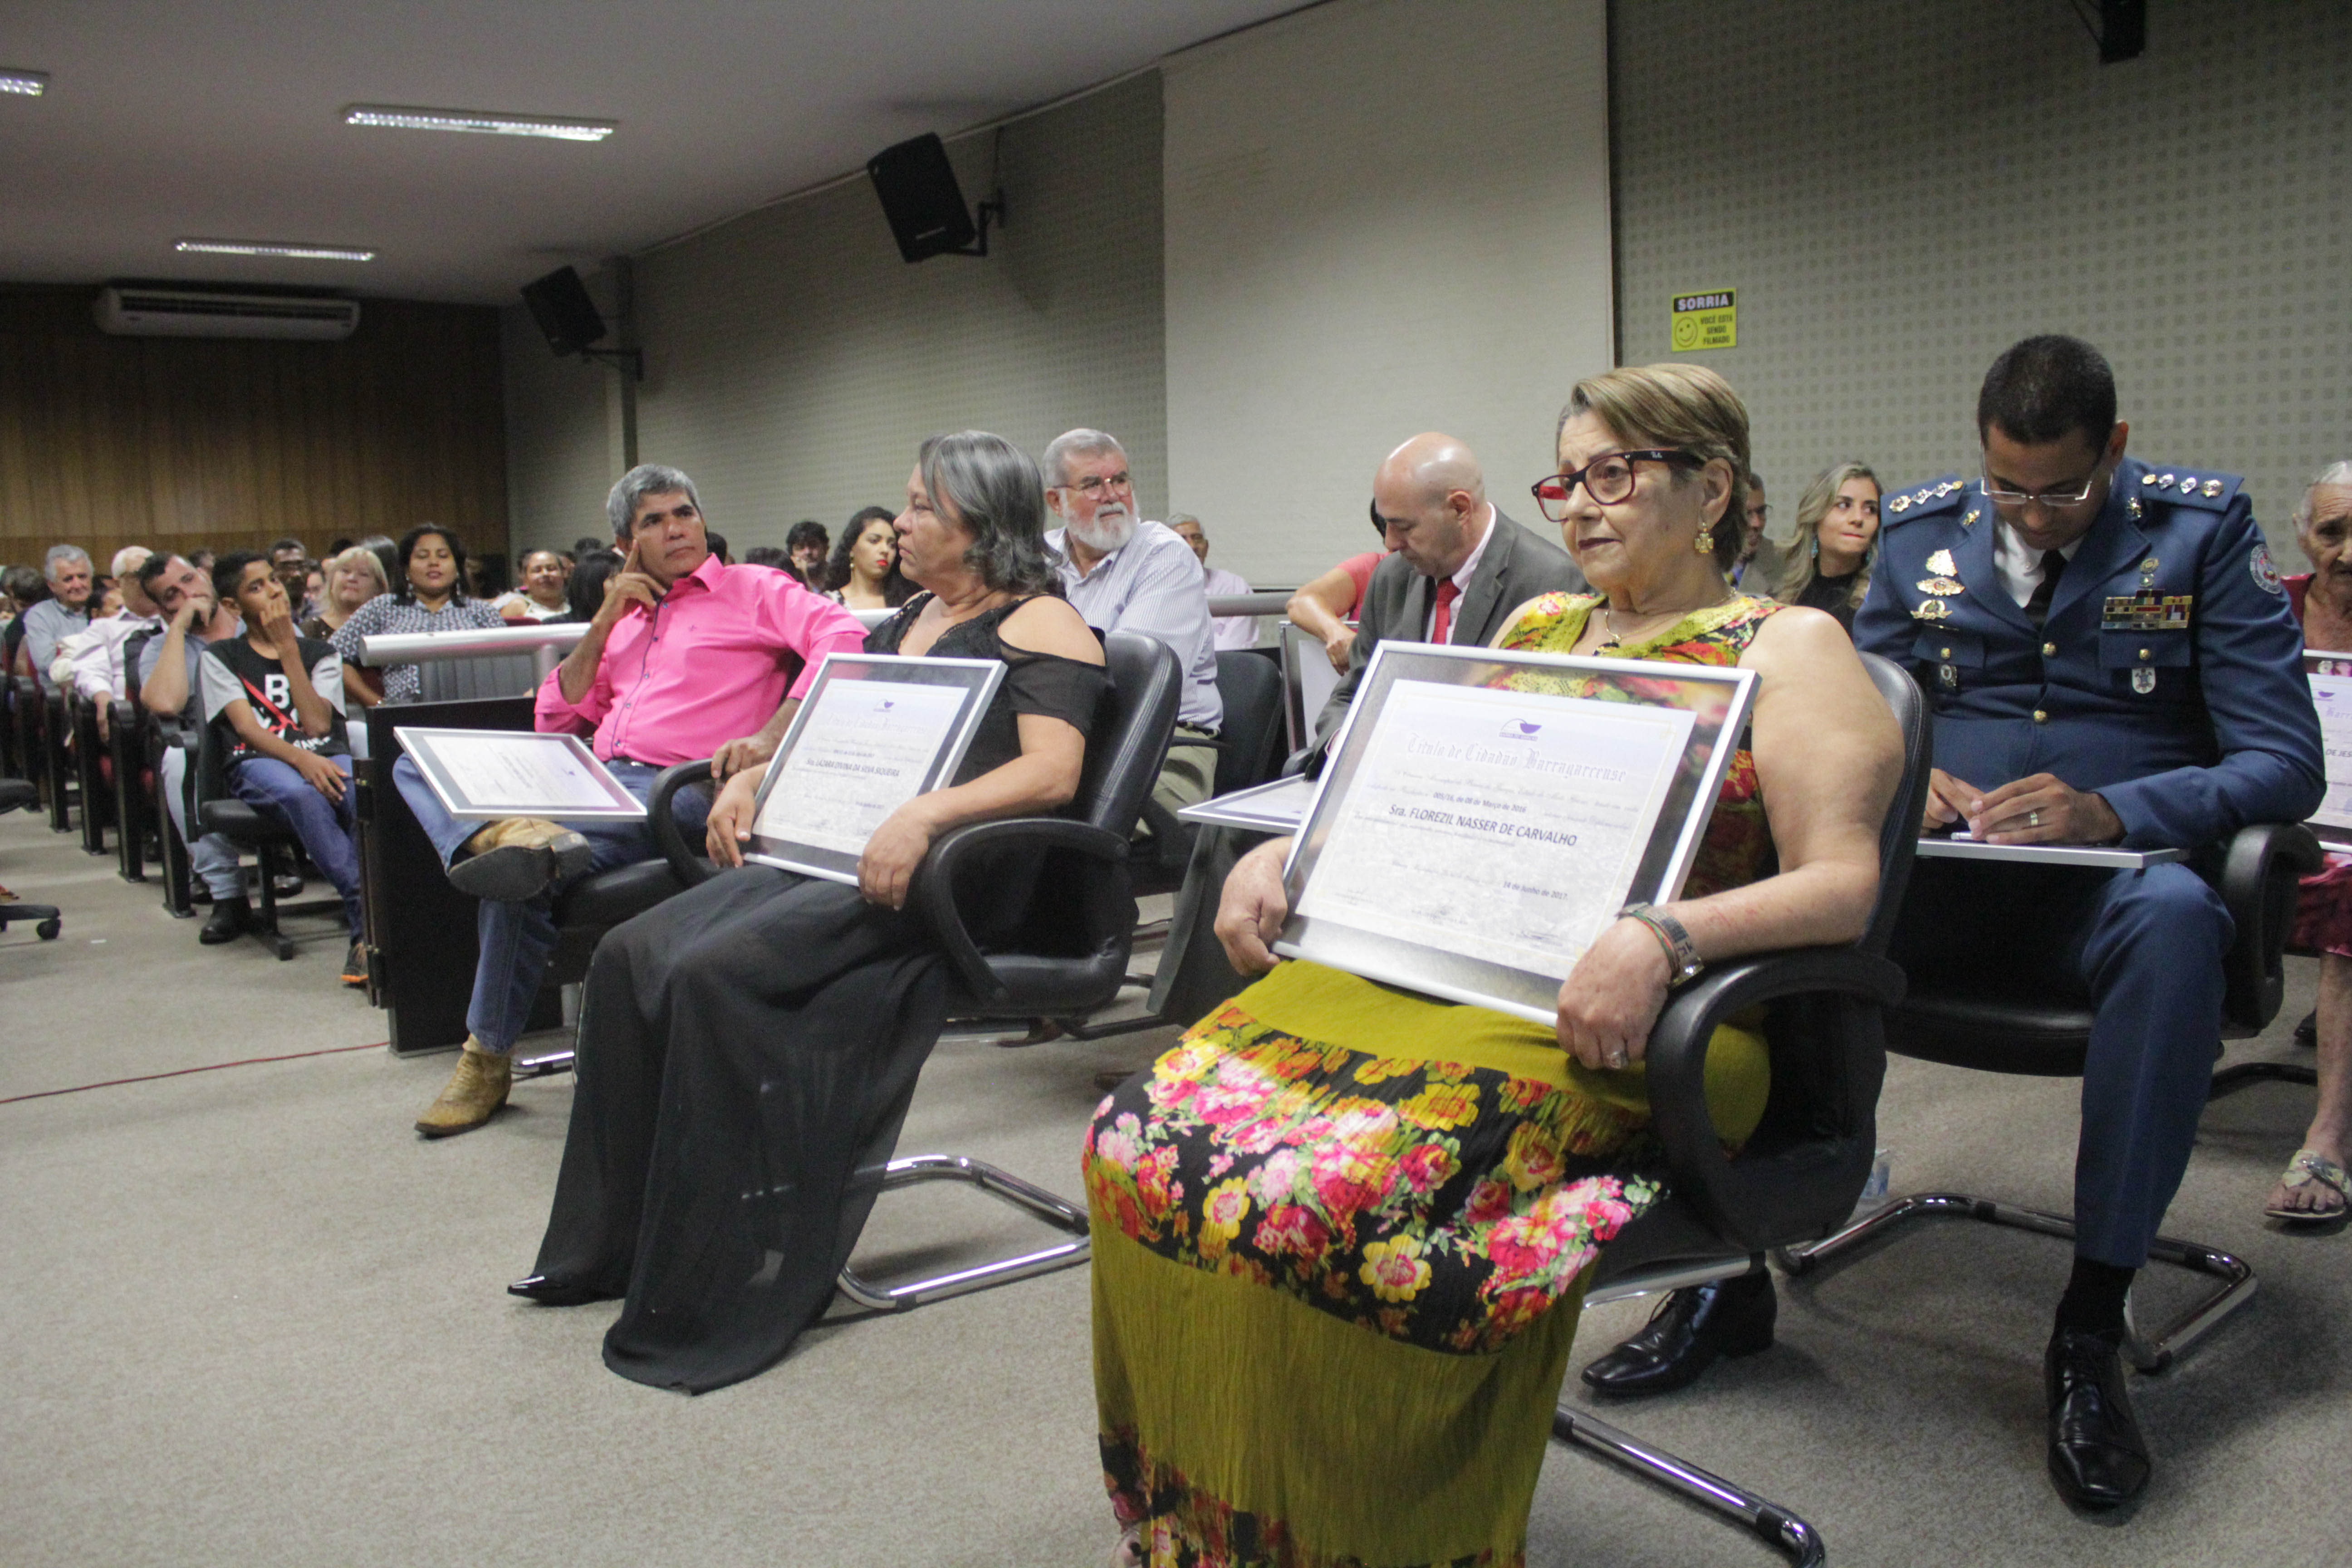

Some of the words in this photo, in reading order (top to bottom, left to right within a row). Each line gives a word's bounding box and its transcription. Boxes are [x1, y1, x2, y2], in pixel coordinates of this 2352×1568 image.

[1678, 294, 1729, 311] SORRIA
[1707, 325, 1726, 334] SENDO
[1703, 335, 1730, 344] FILMADO
[1482, 799, 1501, 810] Março
[1501, 803, 1510, 811] de
[1511, 804, 1527, 813] 2016
[1389, 804, 1406, 817] Sra.
[1410, 808, 1454, 825] FLOREZIL
[1456, 815, 1498, 833] NASSER
[1499, 823, 1515, 836] DE
[1516, 826, 1578, 846] CARVALHO
[1521, 885, 1540, 895] Junho
